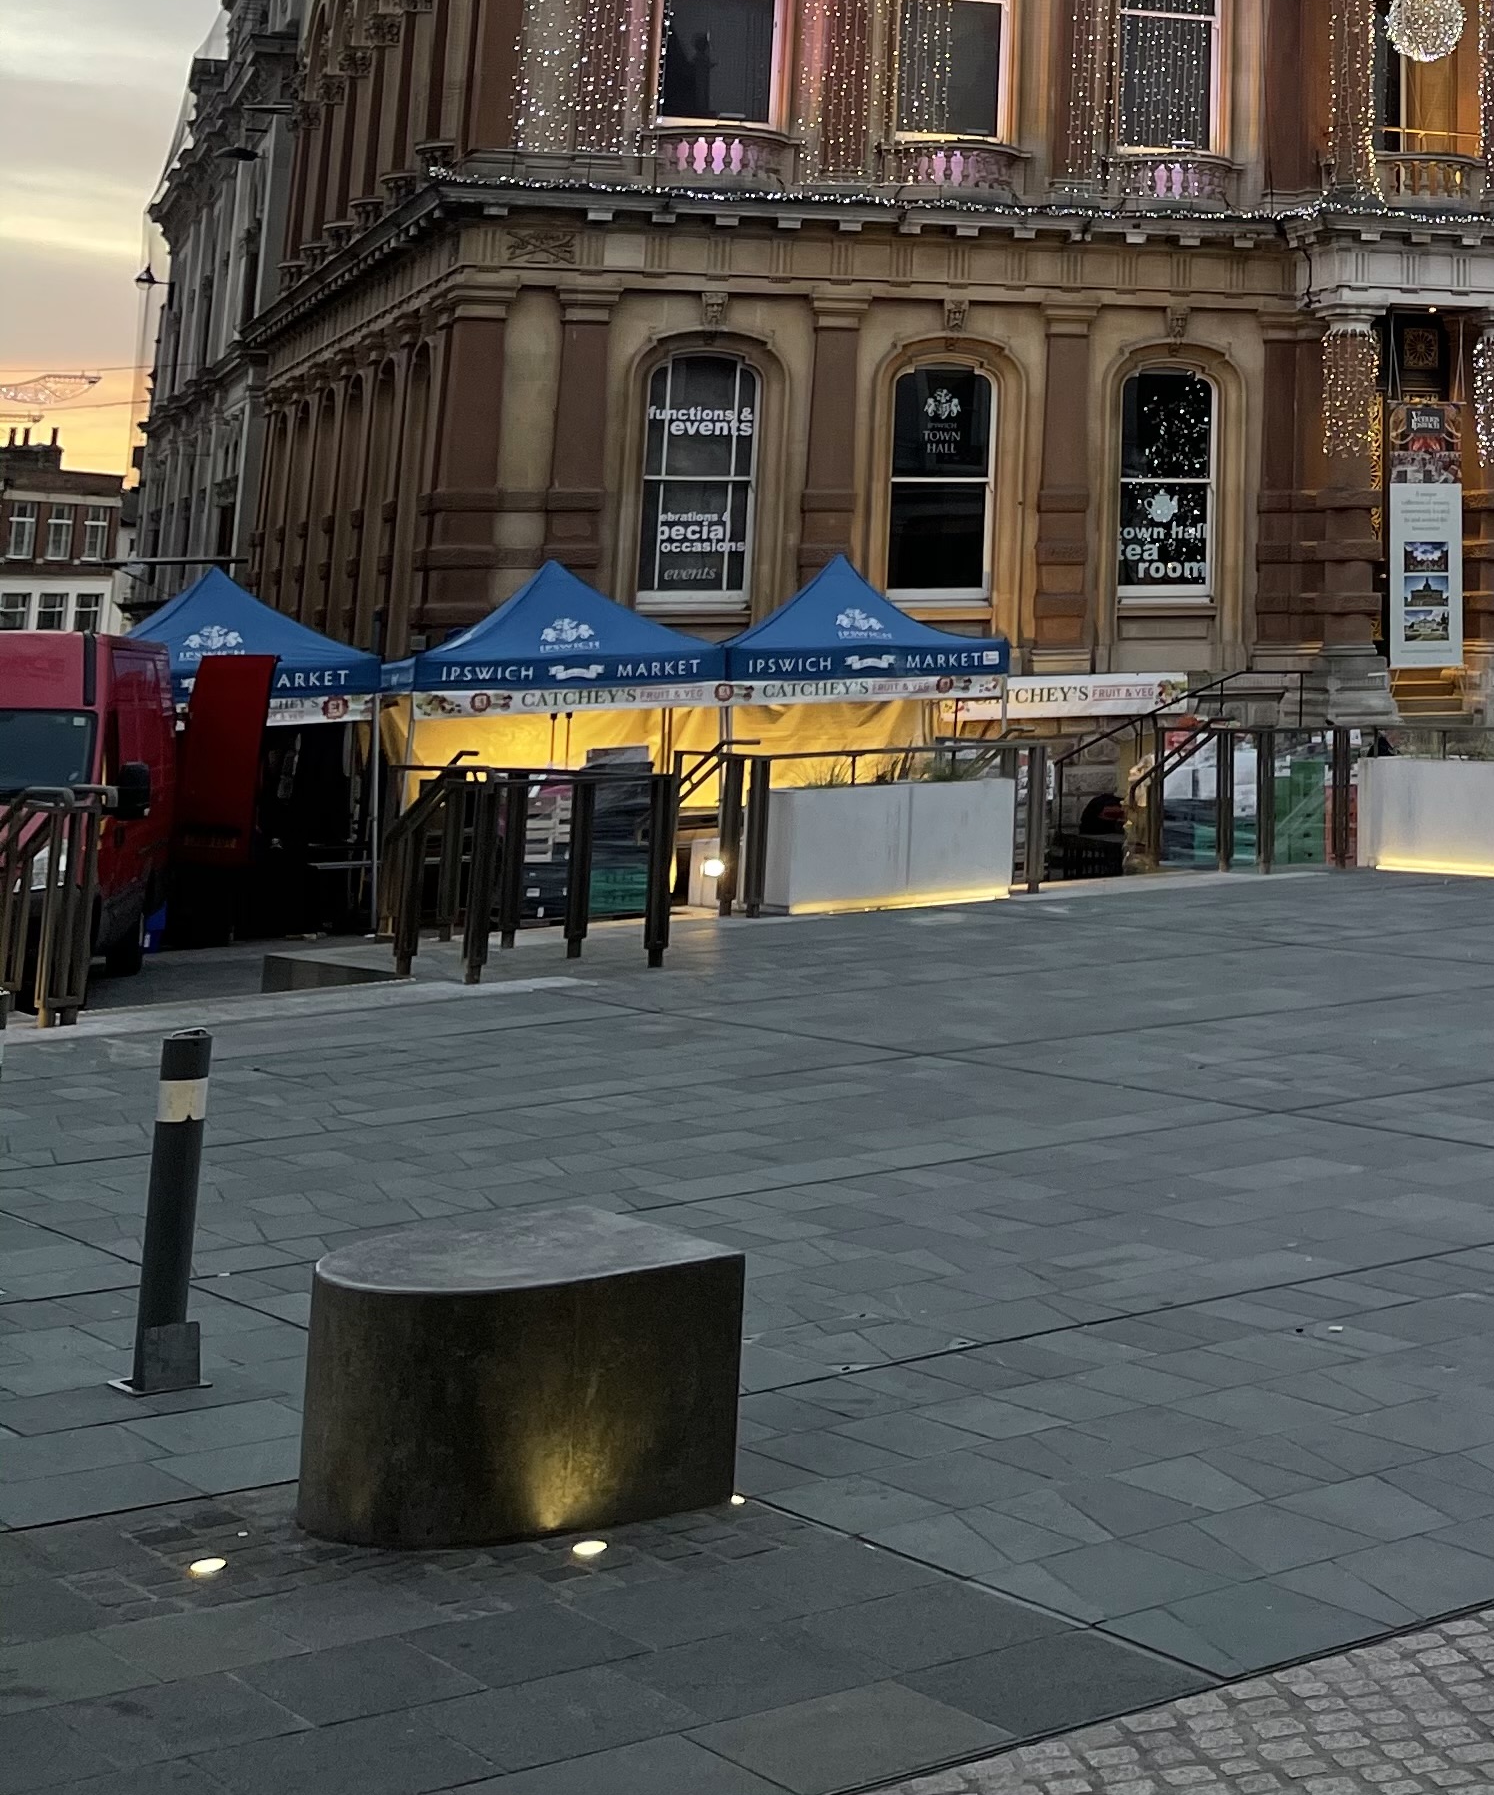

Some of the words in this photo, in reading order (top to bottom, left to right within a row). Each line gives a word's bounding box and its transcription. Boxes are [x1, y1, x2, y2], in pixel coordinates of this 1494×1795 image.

[649, 406, 734, 420] functions
[740, 407, 753, 420] &
[670, 421, 752, 436] events
[922, 431, 960, 441] TOWN
[927, 443, 957, 453] HALL
[660, 512, 718, 521] ebrations
[1119, 526, 1165, 539] own
[661, 539, 745, 552] occasions
[663, 566, 717, 581] events
[1138, 562, 1206, 578] room
[748, 656, 832, 673] IPSWICH
[906, 652, 982, 669] MARKET
[441, 665, 533, 682] IPSWICH
[617, 659, 700, 678] MARKET
[276, 669, 350, 689] ARKET
[640, 689, 670, 700] FRUIT
[684, 688, 703, 698] VEG
[975, 686, 1088, 705] TCHEY'S
[1092, 688, 1122, 698] FRUIT
[1125, 687, 1132, 697] &
[1135, 687, 1154, 697] VEG
